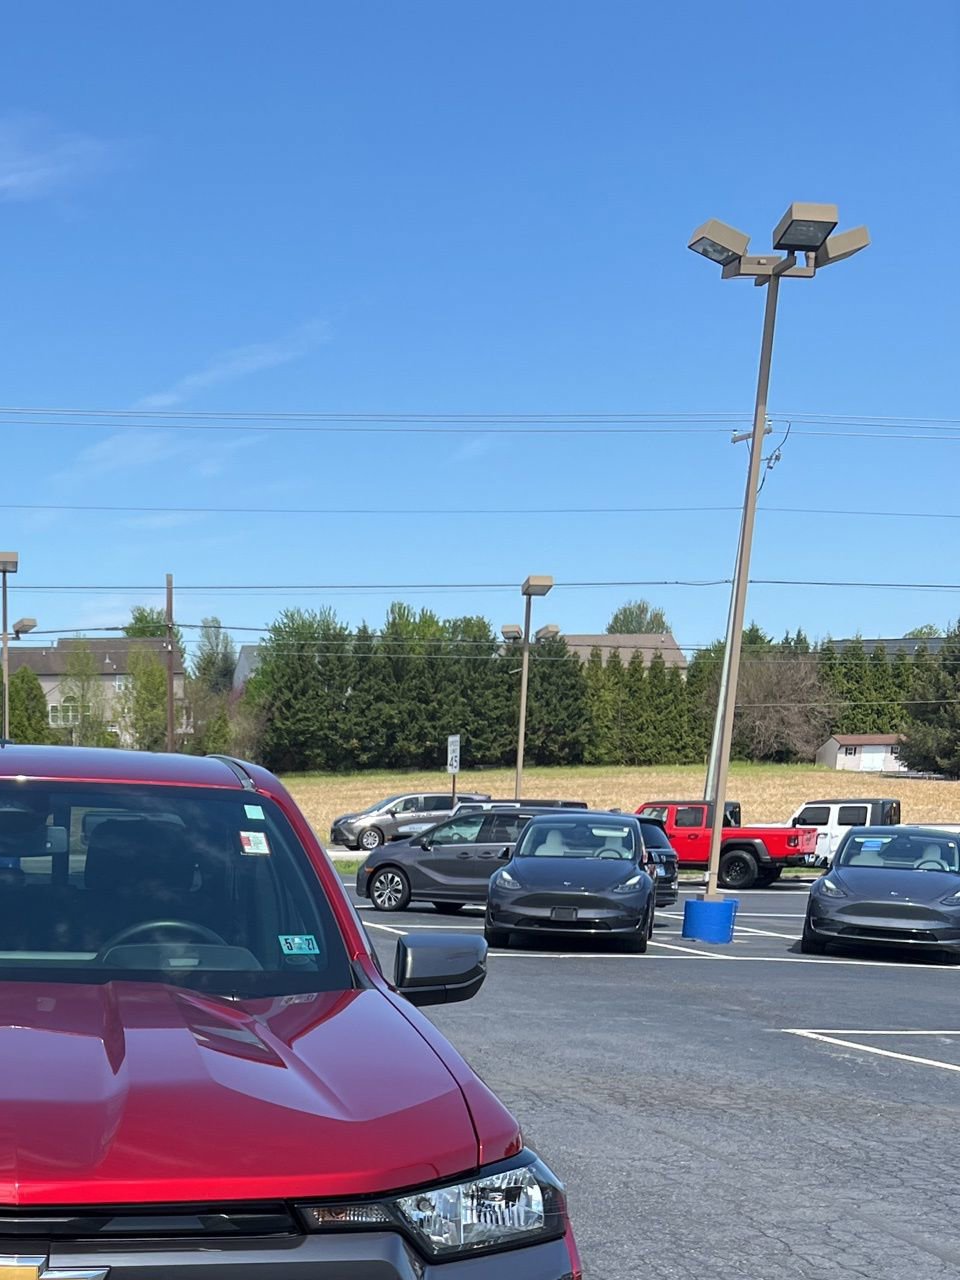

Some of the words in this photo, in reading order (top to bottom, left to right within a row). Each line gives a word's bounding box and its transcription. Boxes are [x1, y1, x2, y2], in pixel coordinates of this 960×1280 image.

[449, 755, 458, 769] 45
[284, 938, 293, 950] 5
[305, 938, 314, 950] 27
